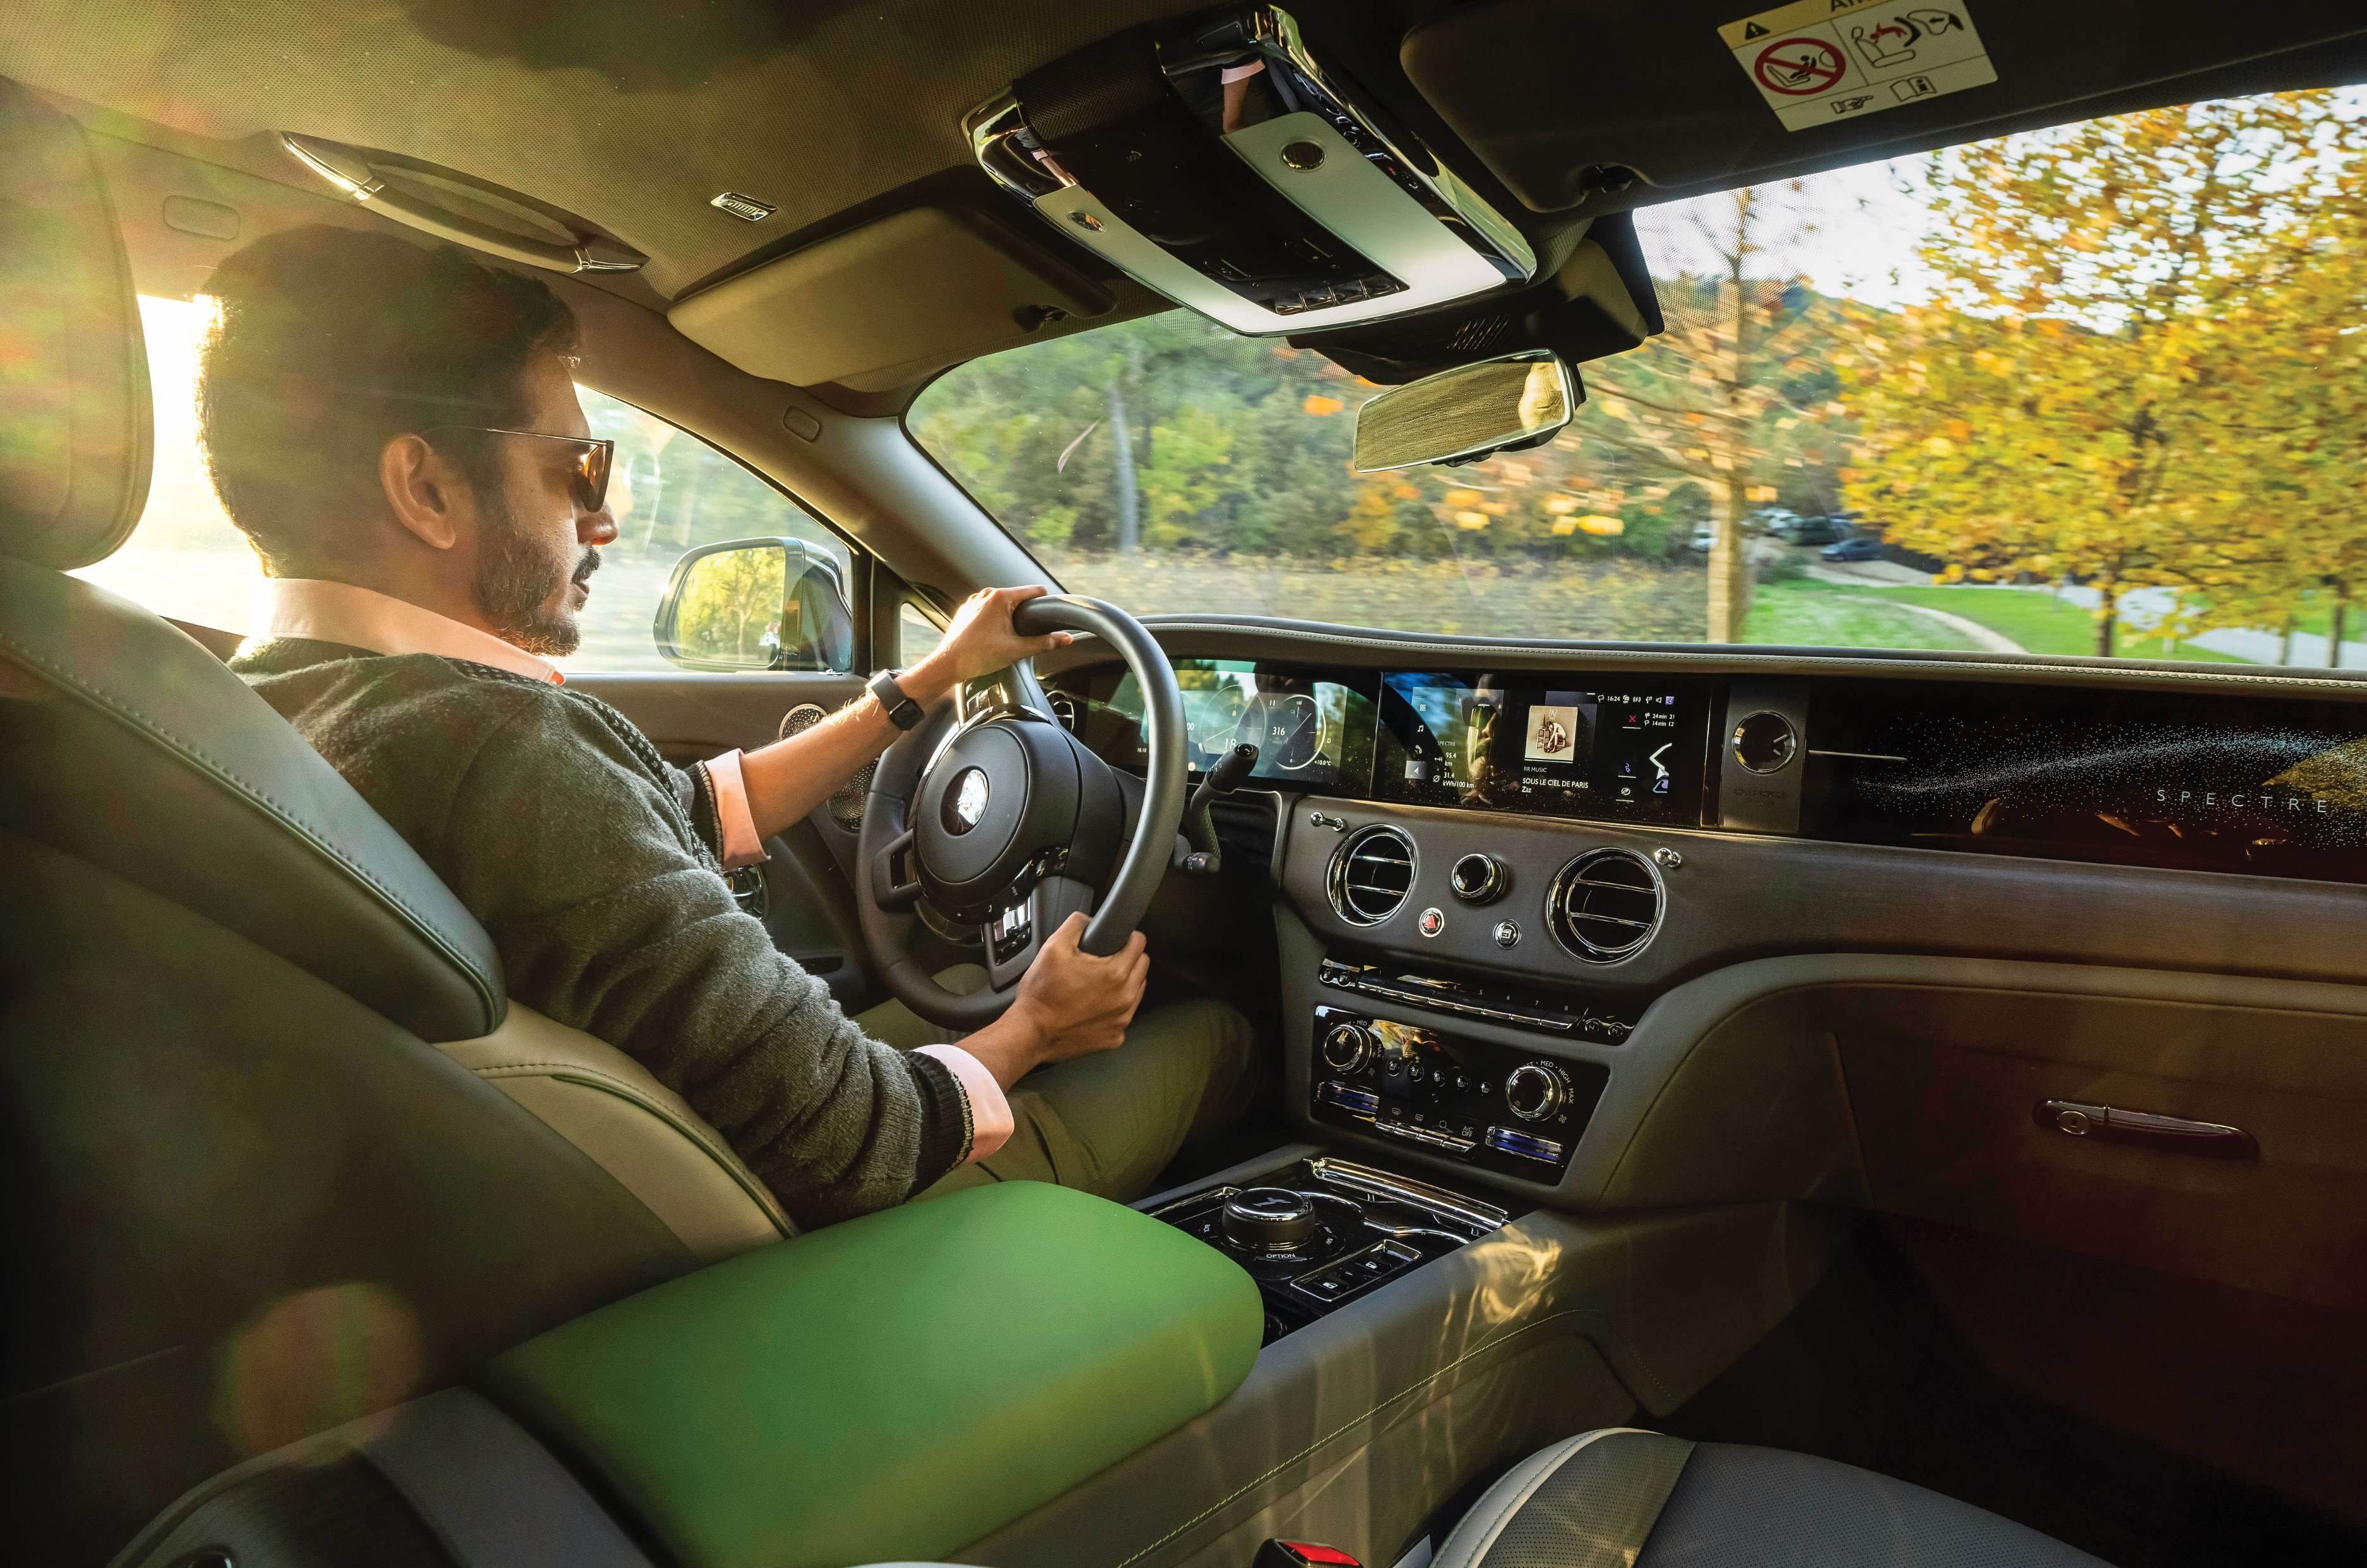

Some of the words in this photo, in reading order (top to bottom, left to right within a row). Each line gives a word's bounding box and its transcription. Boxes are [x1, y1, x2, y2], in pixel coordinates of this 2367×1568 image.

[1548, 708, 1558, 717] ZAZ
[1272, 727, 1286, 736] 316
[1442, 780, 1466, 788] kWh/100
[1571, 781, 1589, 789] PARIS
[2156, 789, 2327, 813] SPECTRE
[1558, 1067, 1571, 1084] HIGH
